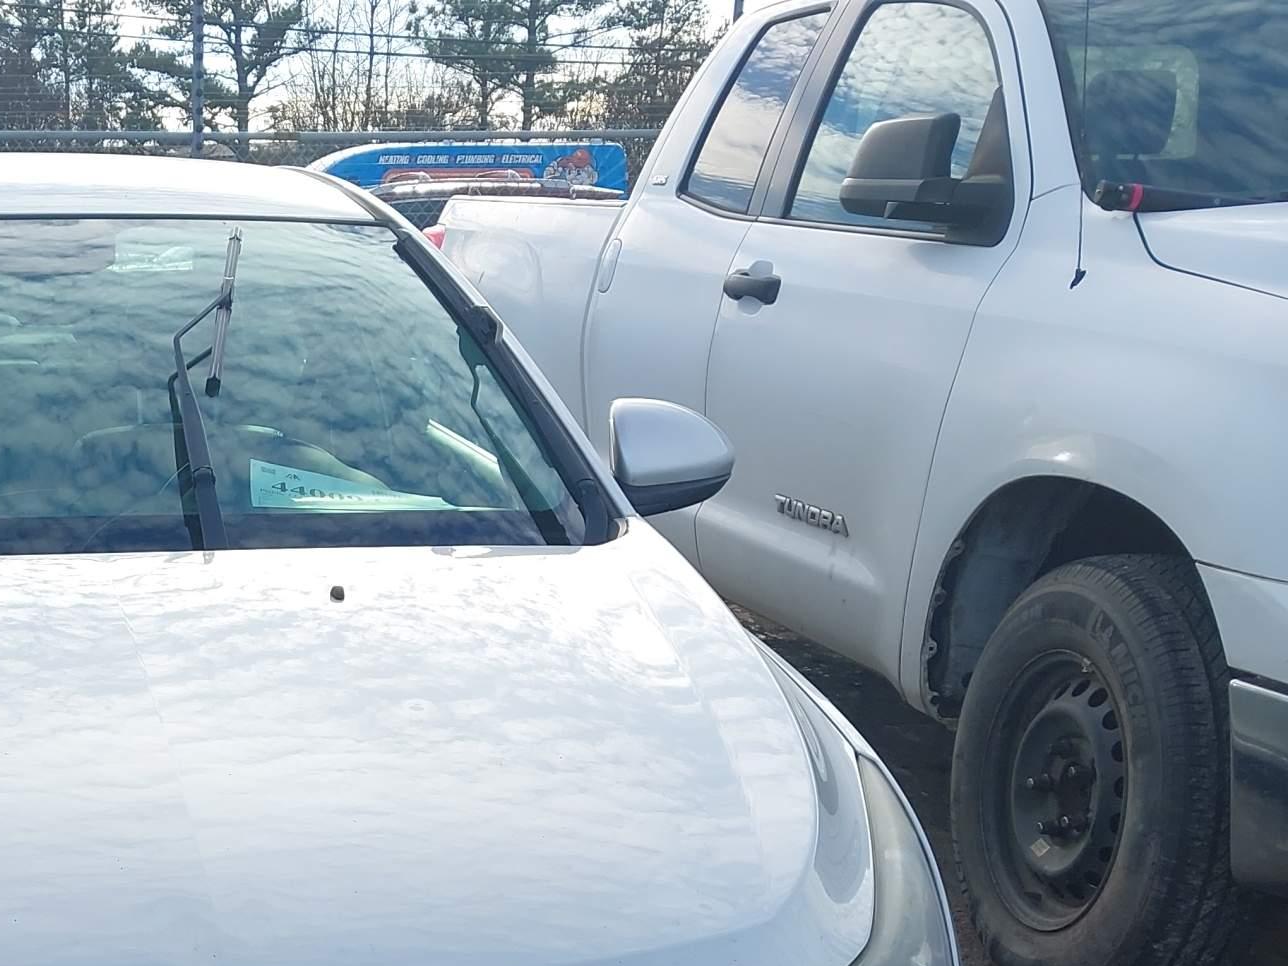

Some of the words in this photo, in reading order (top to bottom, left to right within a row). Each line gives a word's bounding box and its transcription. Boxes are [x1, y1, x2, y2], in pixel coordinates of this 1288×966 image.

[378, 154, 410, 165] HEATING
[416, 154, 450, 165] COOLING
[455, 153, 496, 164] PLUMBING
[501, 153, 544, 164] ELECTRICAL
[774, 493, 849, 538] TUNDRA
